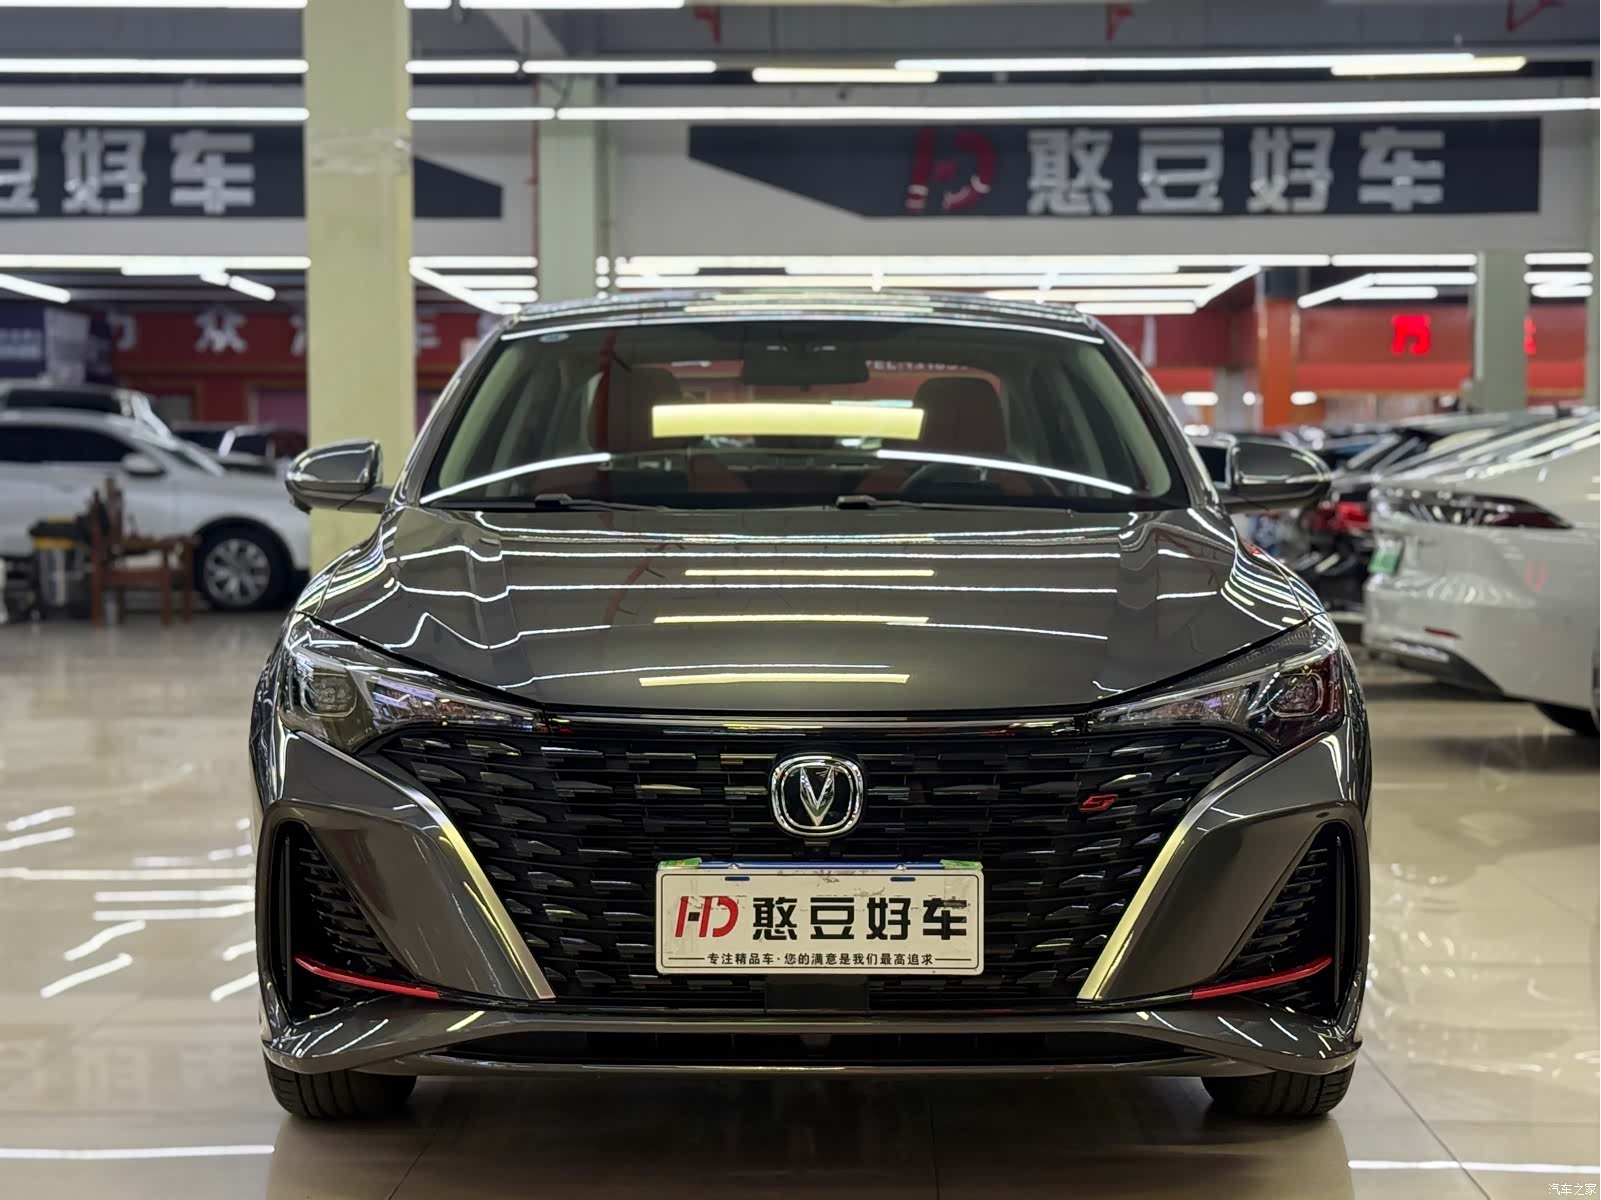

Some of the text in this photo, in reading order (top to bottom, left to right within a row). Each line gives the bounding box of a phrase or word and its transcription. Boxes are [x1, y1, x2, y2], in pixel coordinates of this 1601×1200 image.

[1027, 126, 1445, 215] 憨豆好车
[675, 895, 967, 941] HD 憨豆好车
[707, 952, 933, 966] 专注精品车·您的满意是我们最高追求
